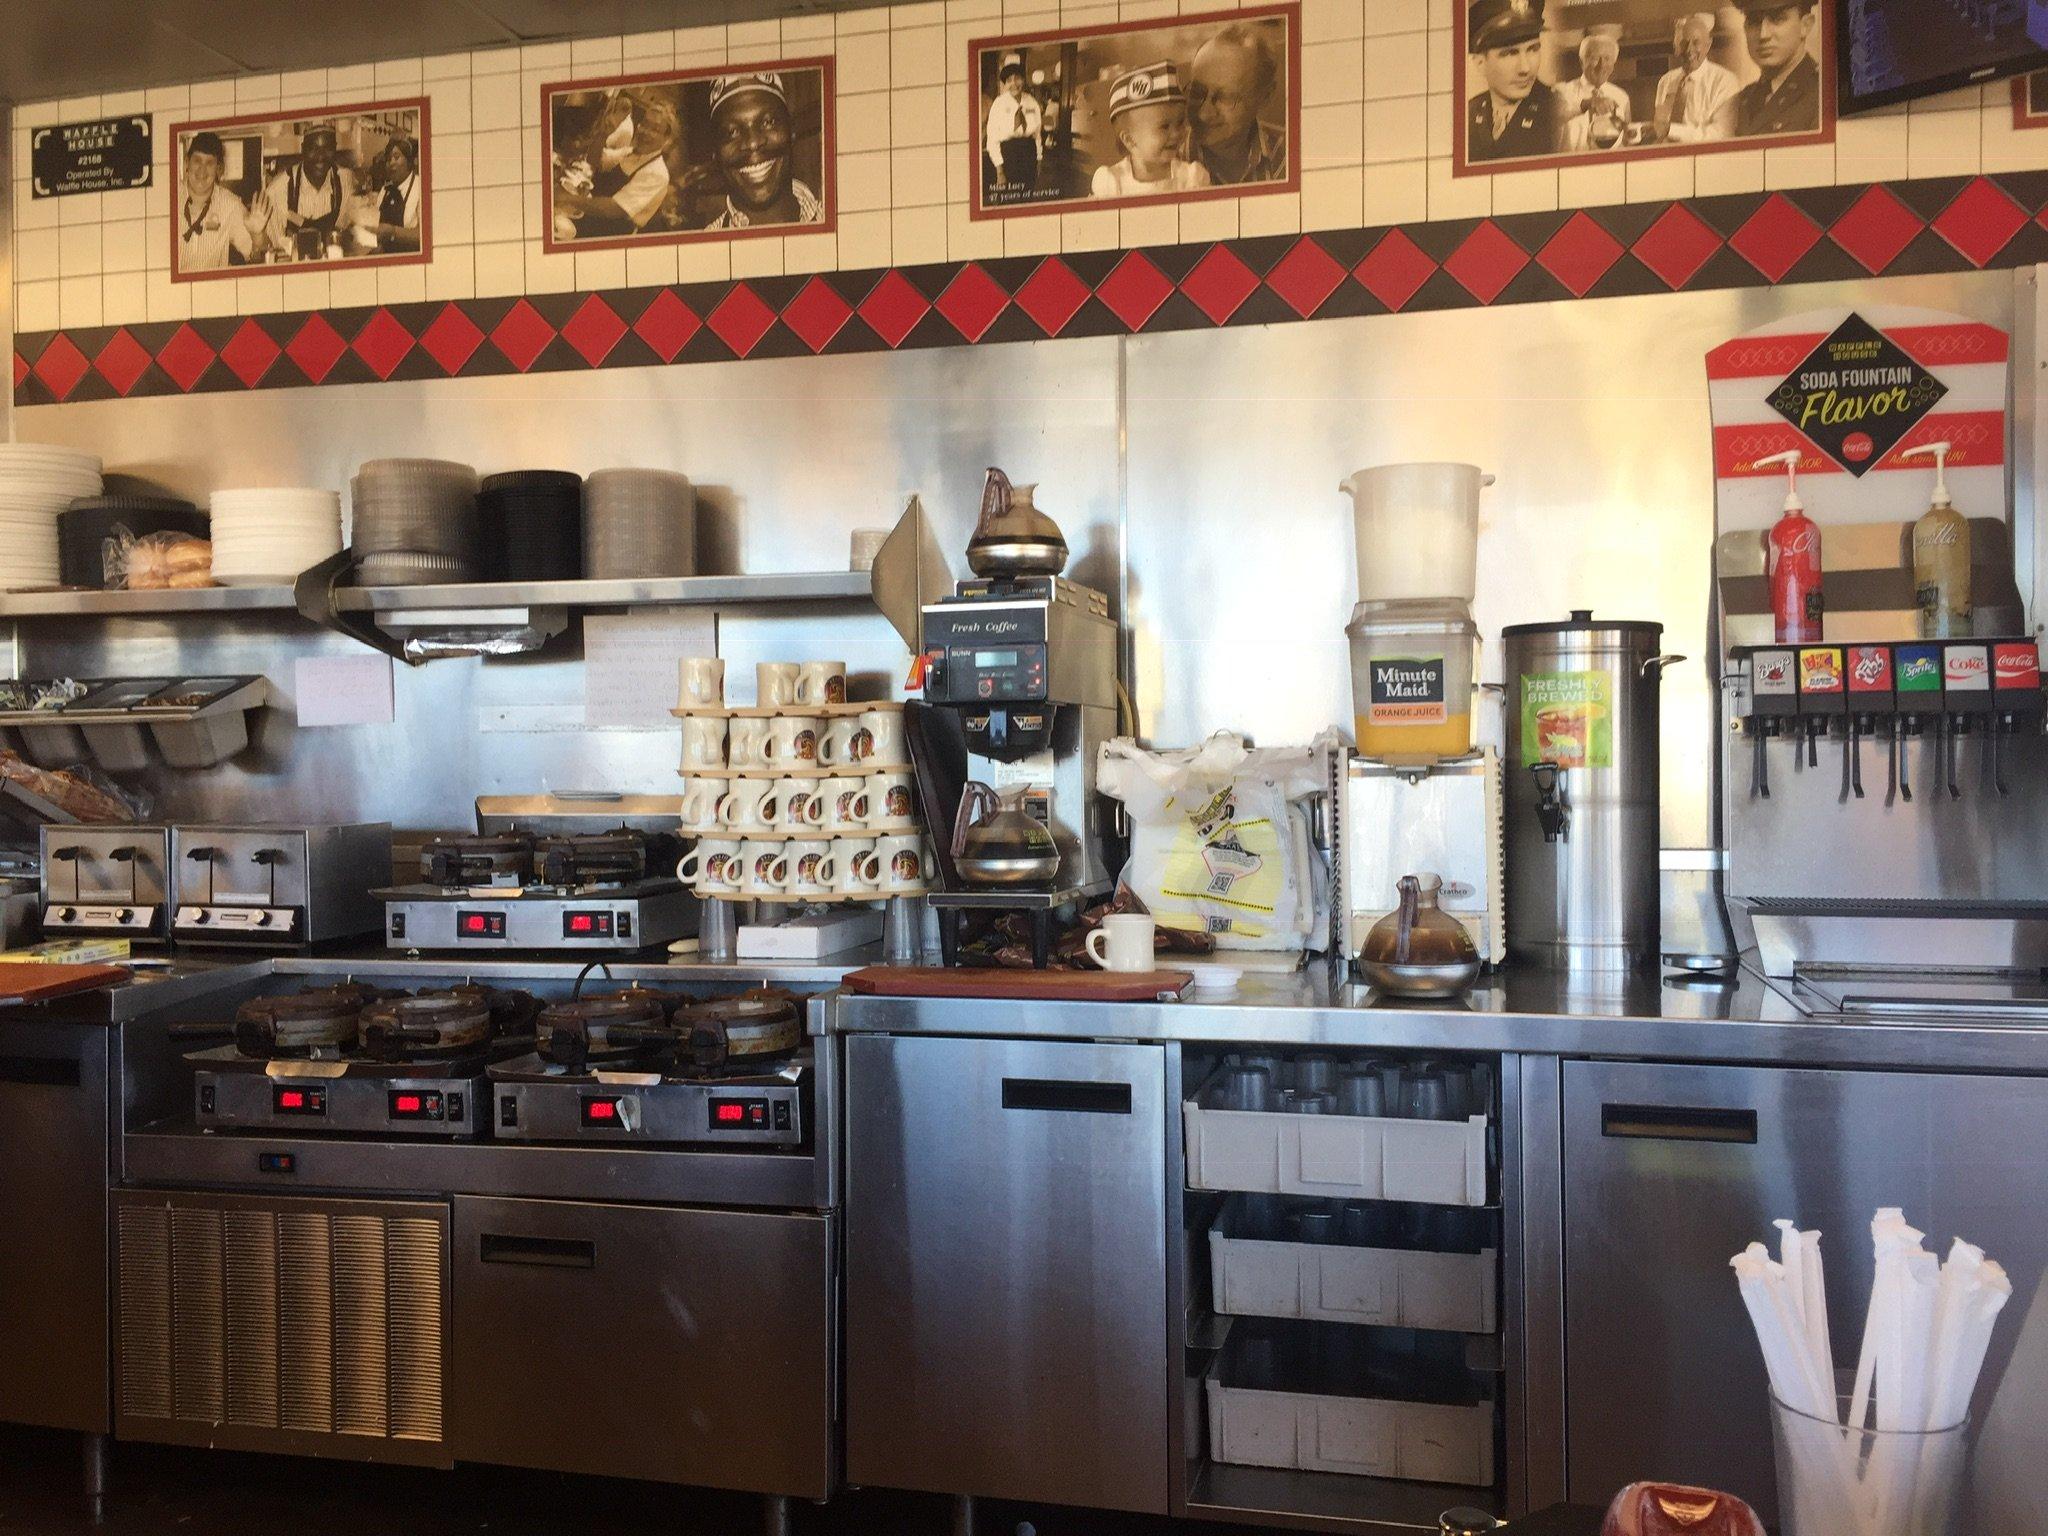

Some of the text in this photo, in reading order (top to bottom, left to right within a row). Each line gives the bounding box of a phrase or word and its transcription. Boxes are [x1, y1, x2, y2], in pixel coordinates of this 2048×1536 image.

[63, 124, 118, 140] WAFFLE
[68, 136, 114, 152] HOUSE
[66, 166, 115, 181] Operated By
[56, 181, 80, 192] Waffle
[989, 182, 1026, 191] Miss Lucy
[1000, 191, 1021, 203] years
[1022, 189, 1031, 198] of
[1032, 188, 1060, 198] service
[1800, 366, 1912, 391] SODA FOUNTAIN
[1800, 385, 1911, 431] Flavor
[951, 621, 1019, 634] Fresh Coffee
[951, 649, 972, 658] BUNN
[1903, 662, 1937, 680] Sprite
[1948, 658, 1985, 671] Coke
[1376, 666, 1438, 683] Minute
[1385, 681, 1430, 698] Maid
[1526, 678, 1602, 693] FRESHLY
[1527, 691, 1604, 704] BREWED
[1374, 707, 1442, 718] ORANGE JUICE
